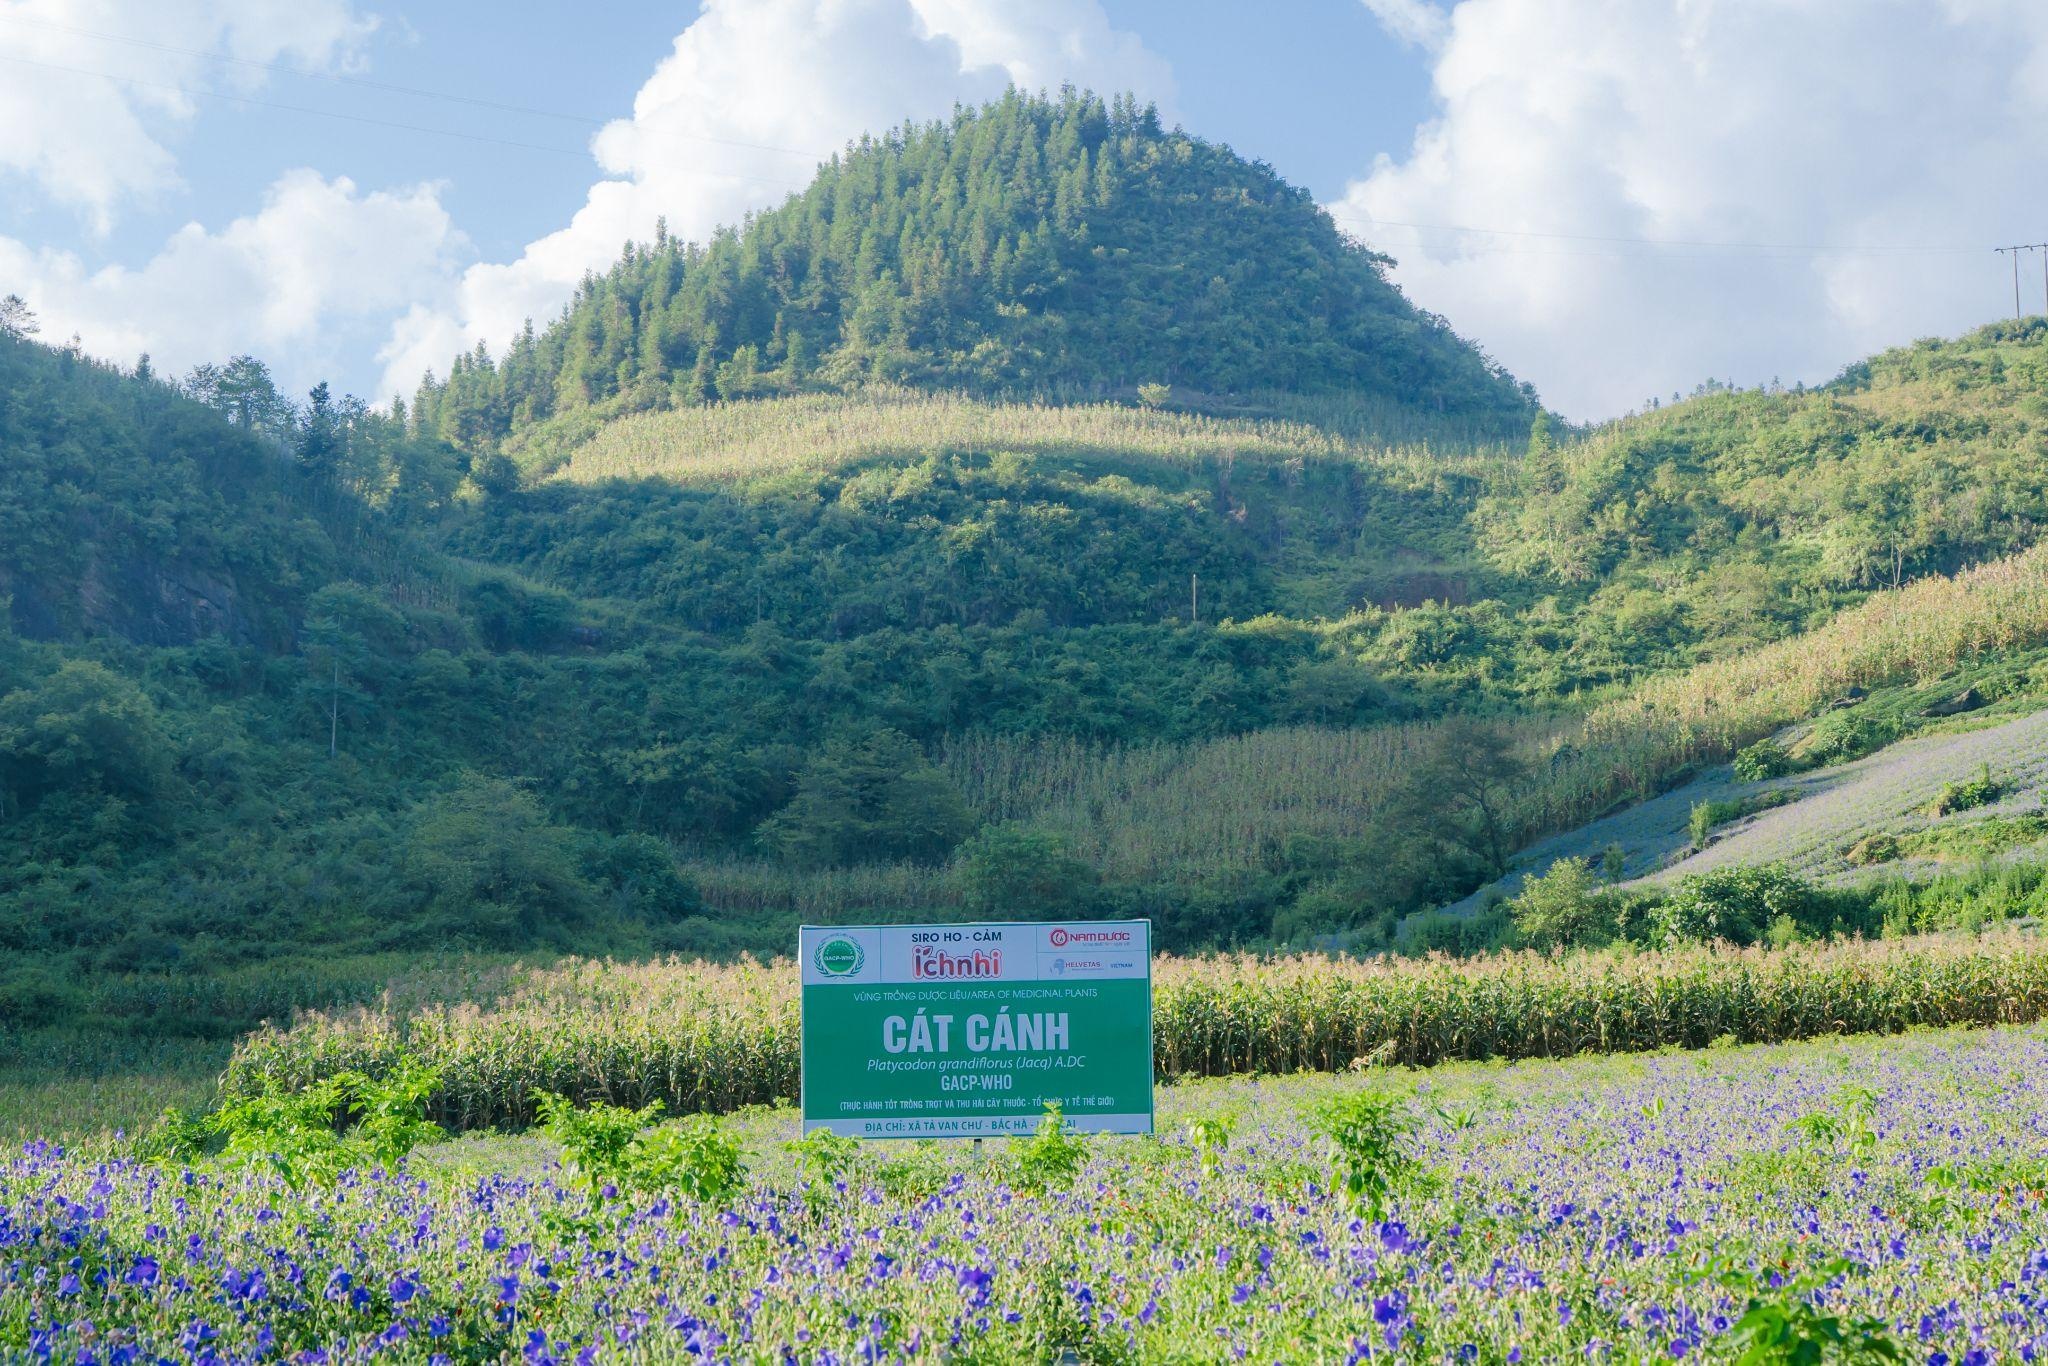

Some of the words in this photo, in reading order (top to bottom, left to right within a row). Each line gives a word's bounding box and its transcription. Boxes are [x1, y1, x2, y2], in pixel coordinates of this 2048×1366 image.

[912, 933, 939, 943] SIRO
[943, 932, 962, 942] HO
[973, 928, 1002, 941] CẢM
[853, 991, 882, 1001] VÙNG
[918, 990, 948, 1002] DƯỢC
[997, 990, 1010, 999] OF
[1012, 989, 1063, 999] MEDICINAL
[1065, 988, 1098, 998] PLANTS
[883, 1006, 953, 1054] CÁT
[966, 1005, 1069, 1052] CÁNH
[867, 1058, 936, 1074] Platycodon
[939, 1057, 1013, 1073] grandiflorus
[1016, 1057, 1052, 1070] (Jacq)
[1054, 1055, 1086, 1068] A.DC
[941, 1074, 1012, 1091] GACP-WHO
[956, 1099, 970, 1108] THU
[1065, 1097, 1070, 1107] Y
[865, 1121, 882, 1134] ĐỊA
[908, 1120, 921, 1131] XÃ
[938, 1121, 958, 1131] VAN
[961, 1120, 983, 1131] CHƯ
[991, 1117, 1011, 1130] BẮC
[1014, 1118, 1027, 1130] HÀ
